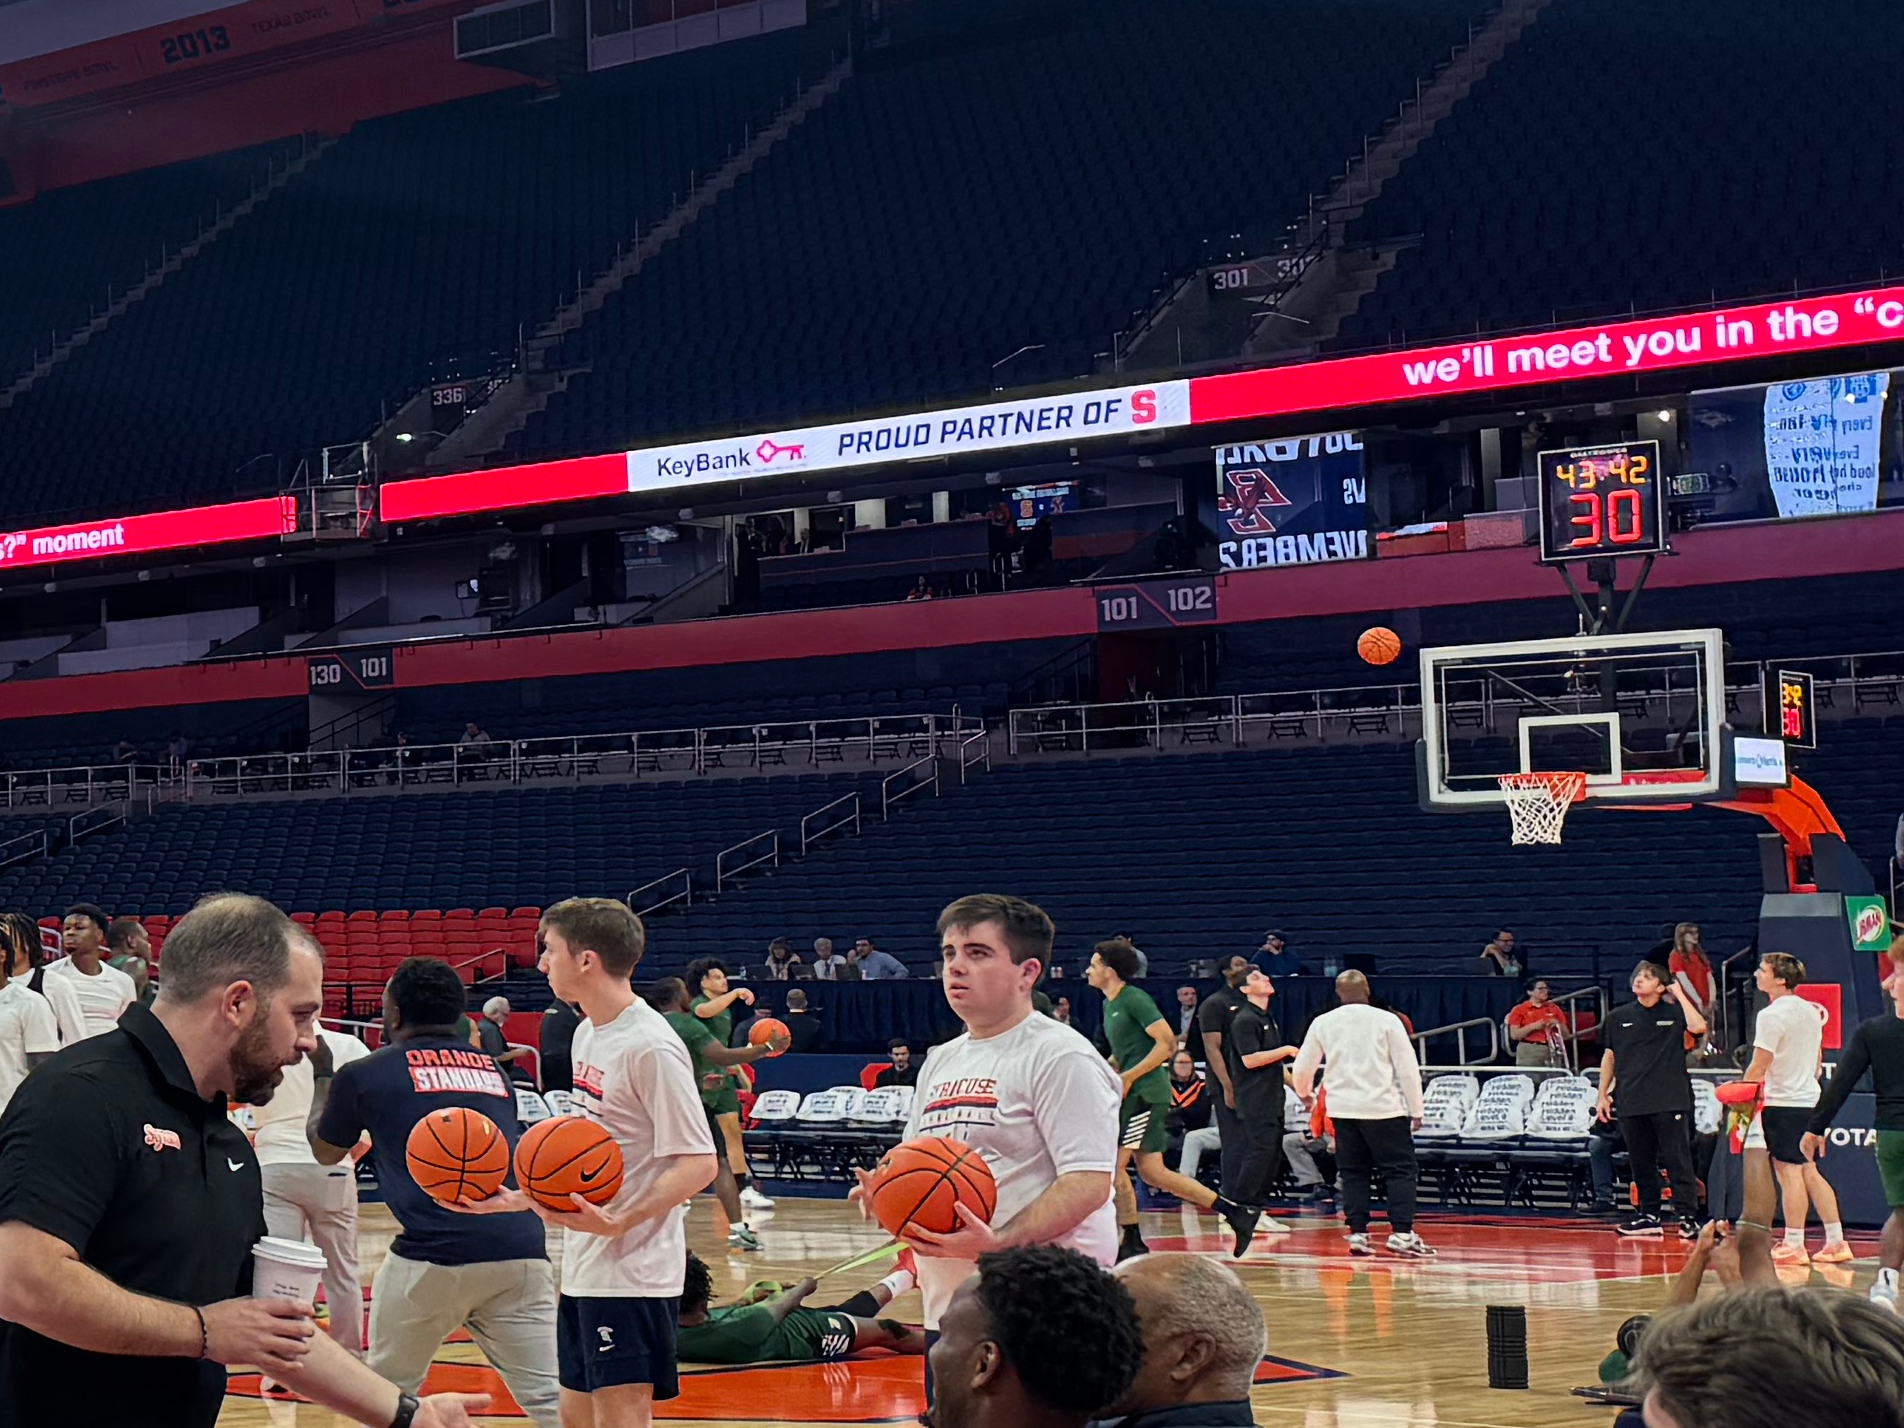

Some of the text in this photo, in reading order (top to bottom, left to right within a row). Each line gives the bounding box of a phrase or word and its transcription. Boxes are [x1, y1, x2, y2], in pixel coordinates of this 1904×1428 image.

[160, 25, 230, 65] 2013
[1214, 268, 1249, 291] 301
[1403, 305, 1840, 386] we'll meet you in the
[432, 386, 463, 406] 336
[657, 448, 751, 477] KeyBank
[838, 424, 930, 456] PROUD
[941, 405, 1072, 444] PARTNER
[1083, 397, 1122, 425] OF
[1569, 489, 1642, 547] 30
[32, 523, 124, 556] moment
[1101, 586, 1212, 622] 101 102
[309, 655, 386, 686] 130 101
